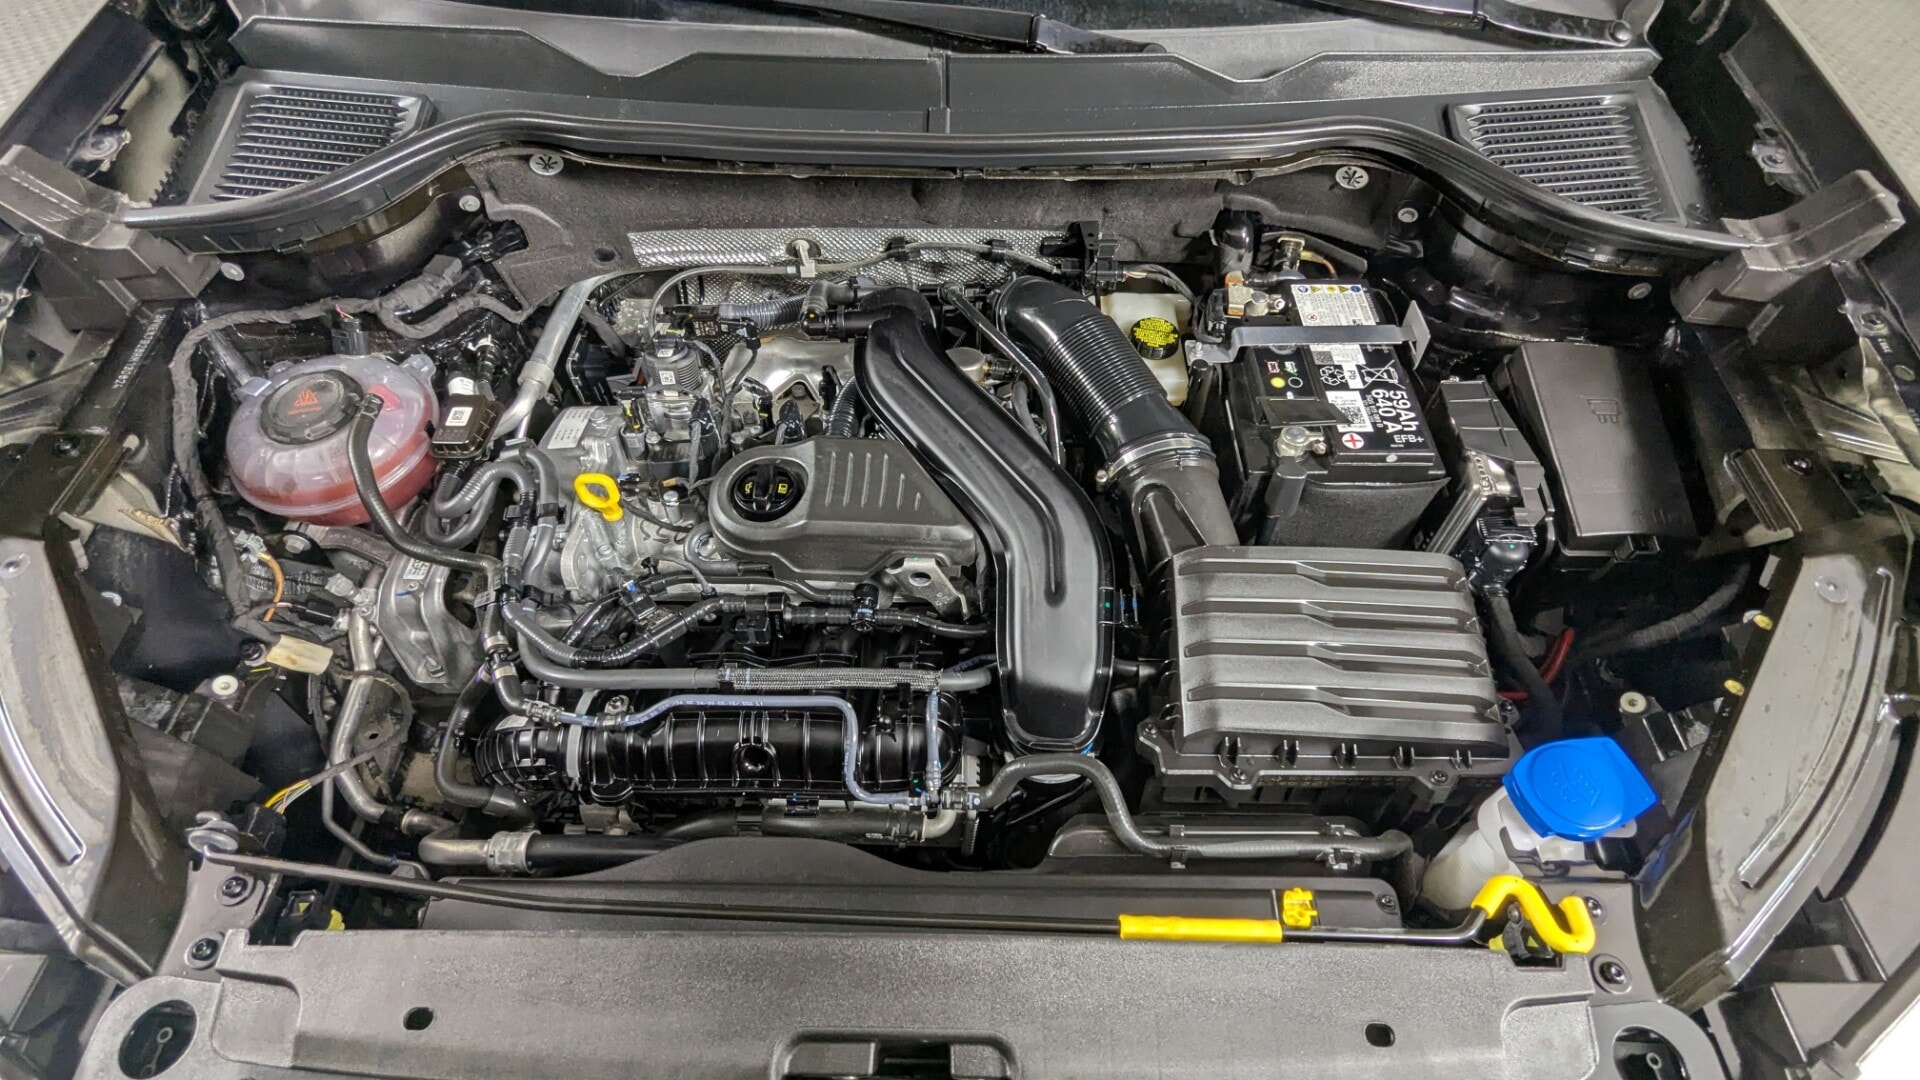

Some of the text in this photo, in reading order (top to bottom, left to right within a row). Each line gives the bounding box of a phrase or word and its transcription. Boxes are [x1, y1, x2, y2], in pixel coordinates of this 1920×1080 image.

[1347, 370, 1356, 380] Pb
[1371, 389, 1396, 417] 640
[1389, 390, 1419, 431] 59Ah
[1382, 420, 1403, 434] A
[1393, 434, 1425, 443] EFB+
